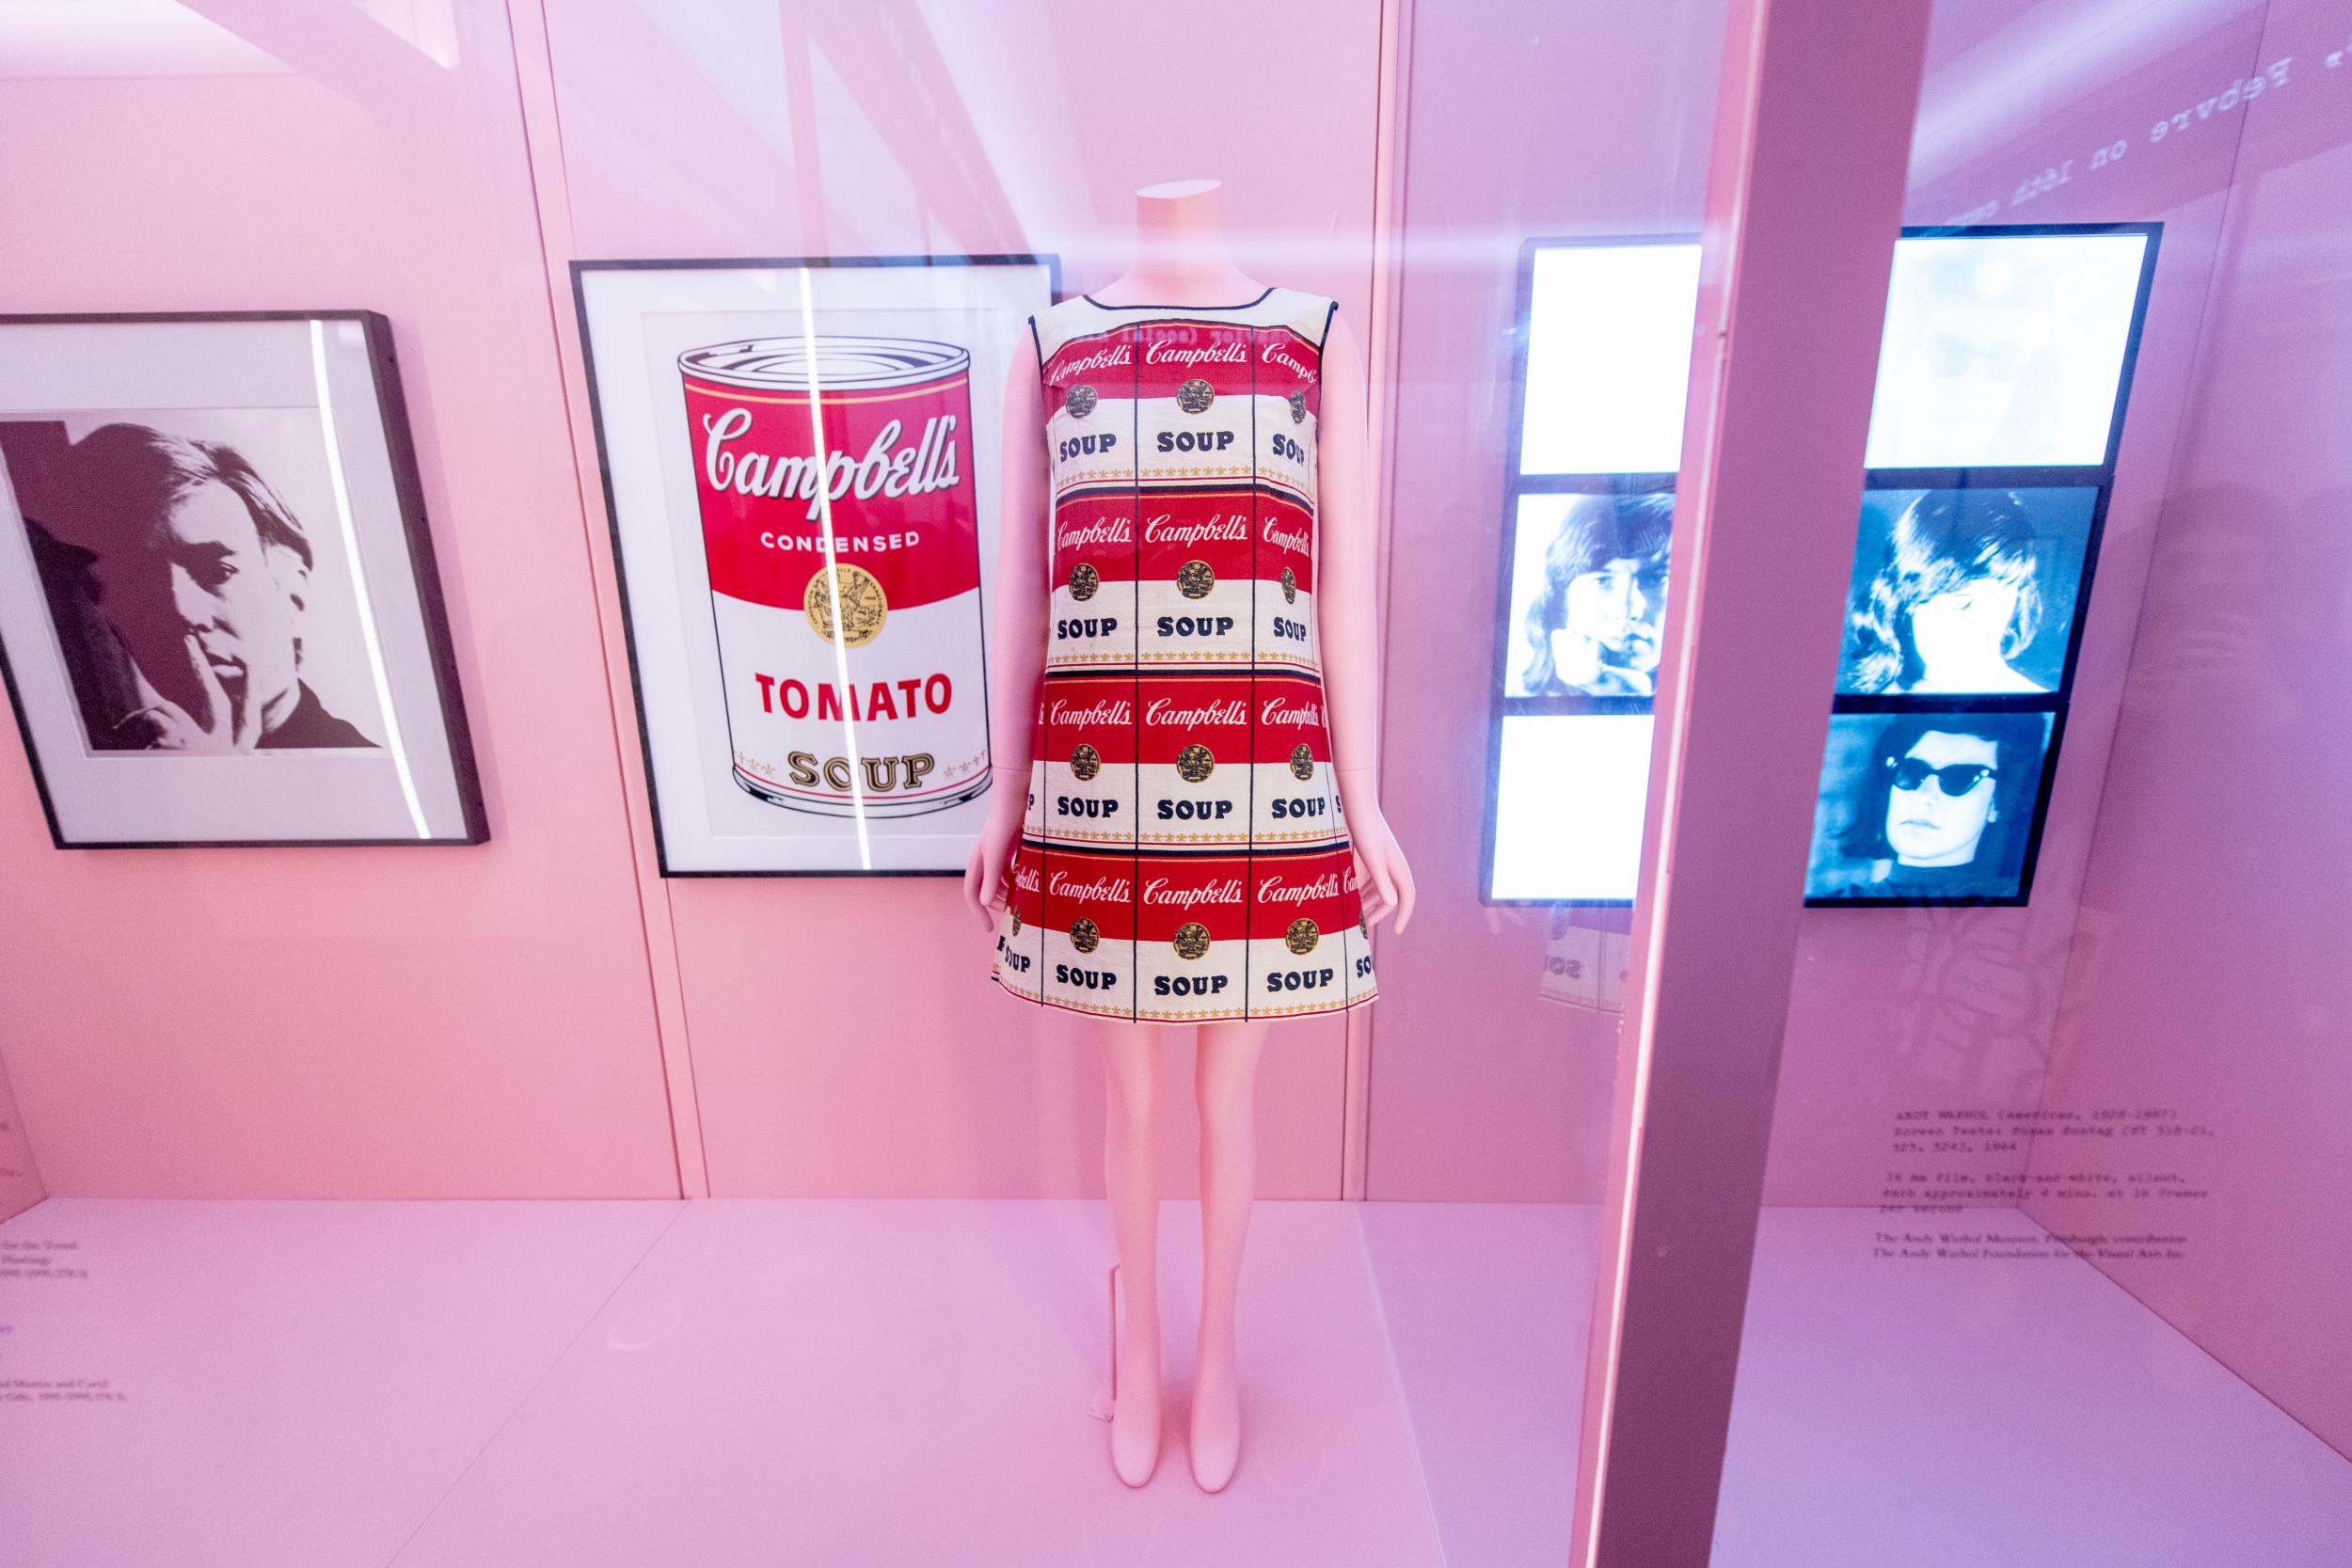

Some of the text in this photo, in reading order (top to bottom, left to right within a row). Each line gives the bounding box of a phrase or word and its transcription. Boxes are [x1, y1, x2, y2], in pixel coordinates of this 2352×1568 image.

[703, 406, 961, 521] Campbell's
[1059, 433, 1117, 463] SOUP
[1156, 431, 1234, 453] SOUP
[760, 531, 920, 553] CONDENSED
[1057, 616, 1306, 641] SOUP SOUP SOUP
[755, 672, 952, 722] TOMATO
[787, 750, 935, 792] SOUP
[1057, 796, 1119, 818] SOUP
[1157, 799, 1233, 820] SOUP
[1271, 796, 1326, 819] SOUP
[1056, 964, 1117, 990] SOUP
[1154, 974, 1229, 996] SOUP
[1266, 968, 1334, 992] SOUP
[1356, 956, 1373, 978] SO
